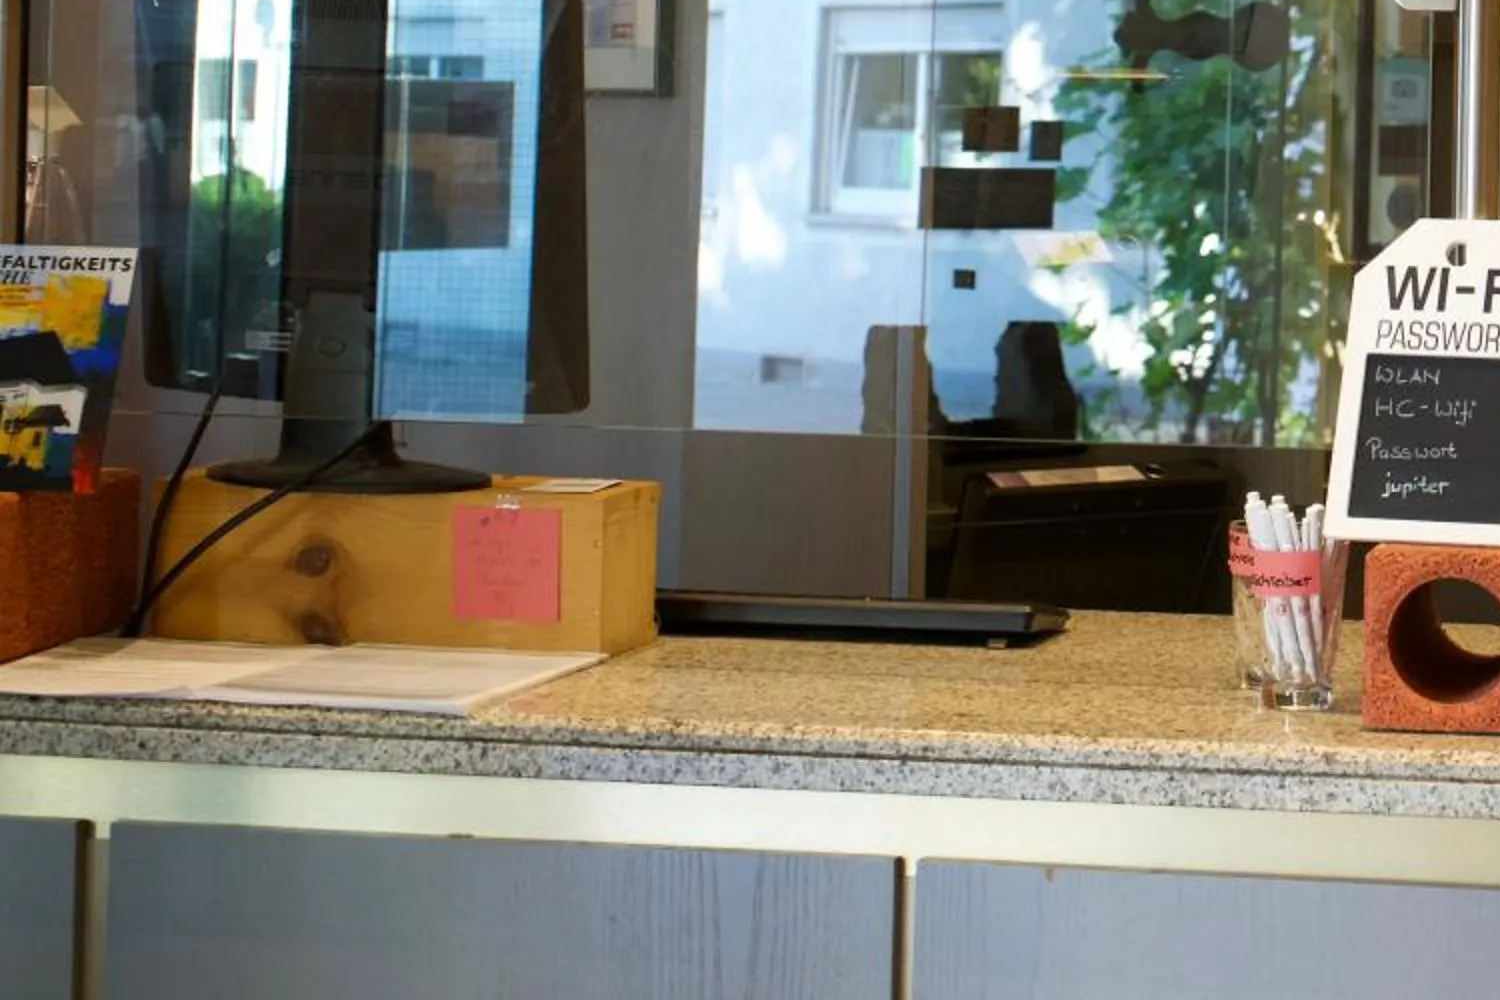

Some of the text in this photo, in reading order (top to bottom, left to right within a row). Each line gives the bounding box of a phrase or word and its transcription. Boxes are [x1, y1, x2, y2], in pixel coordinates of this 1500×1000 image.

[0, 255, 132, 272] FALTIGKEITS
[1375, 365, 1441, 385] WLAN
[1365, 437, 1459, 460] Passwort
[1381, 471, 1452, 499] jupiter
